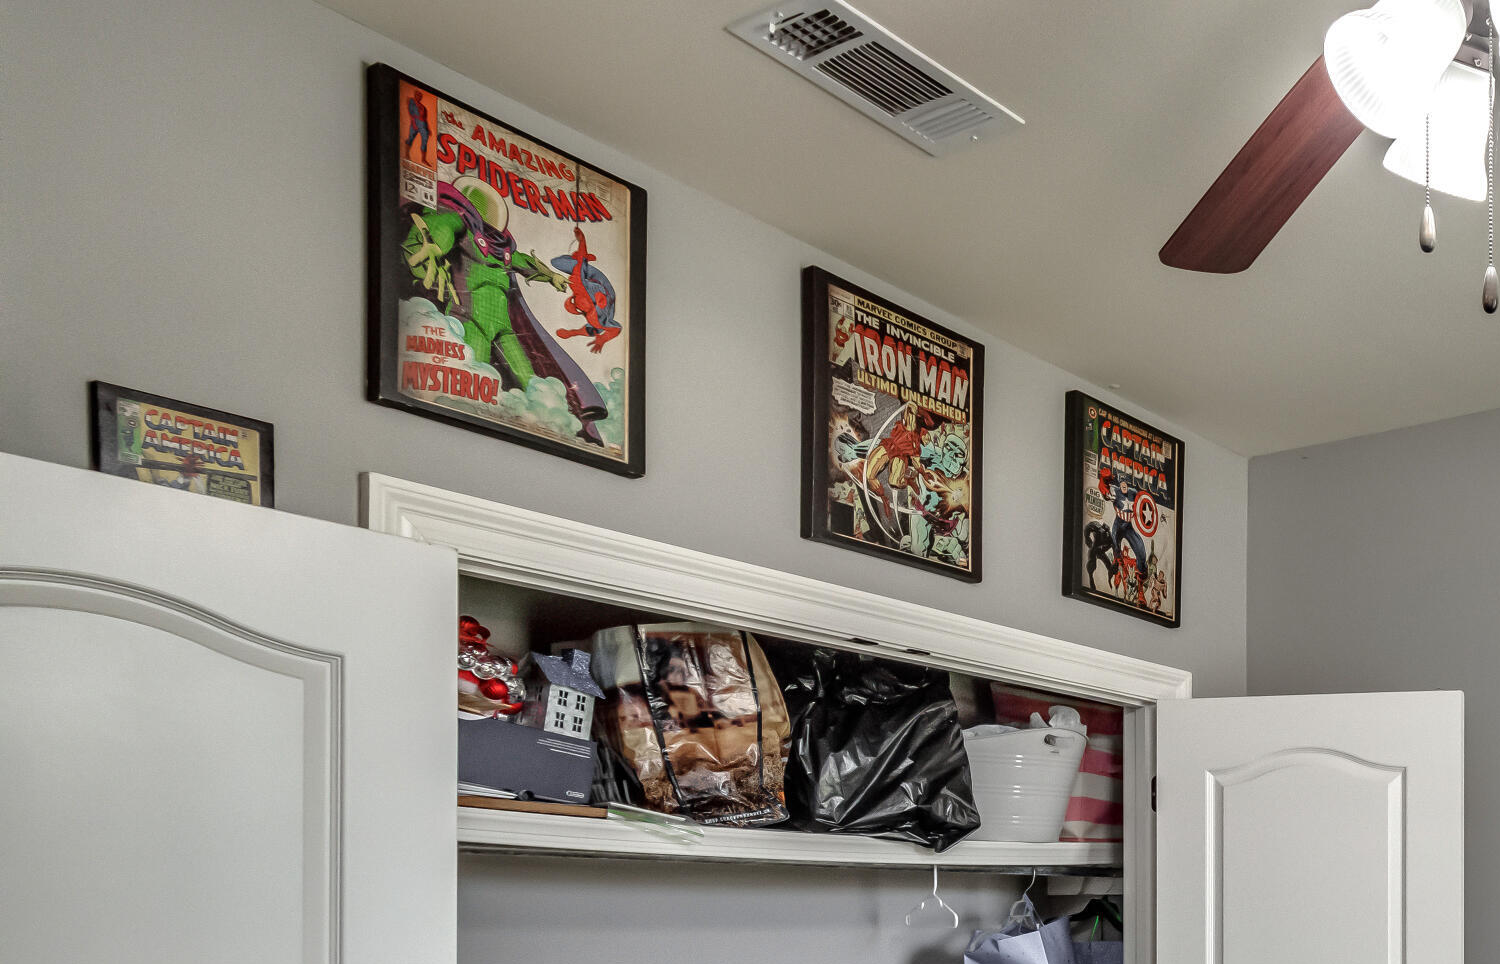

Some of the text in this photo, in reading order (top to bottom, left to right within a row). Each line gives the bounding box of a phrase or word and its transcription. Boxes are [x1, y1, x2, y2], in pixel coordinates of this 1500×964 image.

[437, 133, 613, 223] SPIDER-MAN
[471, 124, 575, 182] AMAZING
[405, 335, 465, 361] MADNESS
[421, 325, 446, 337] THE
[855, 309, 880, 330] THE
[886, 323, 955, 364] INVINCIBLE
[857, 299, 893, 321] MARVEL
[894, 315, 927, 336] COMICS
[930, 331, 958, 349] GROUP
[432, 355, 448, 365] OF
[854, 324, 912, 388] IRON
[401, 360, 500, 405] MYSTERIO!
[857, 368, 898, 397] ULTIMO
[900, 386, 966, 424] UNLEASHED!
[142, 429, 245, 470] AMERICA
[144, 409, 239, 449] CAPTAIN
[1101, 420, 1166, 472] CAPTAIN
[1099, 447, 1168, 500] AMERICA
